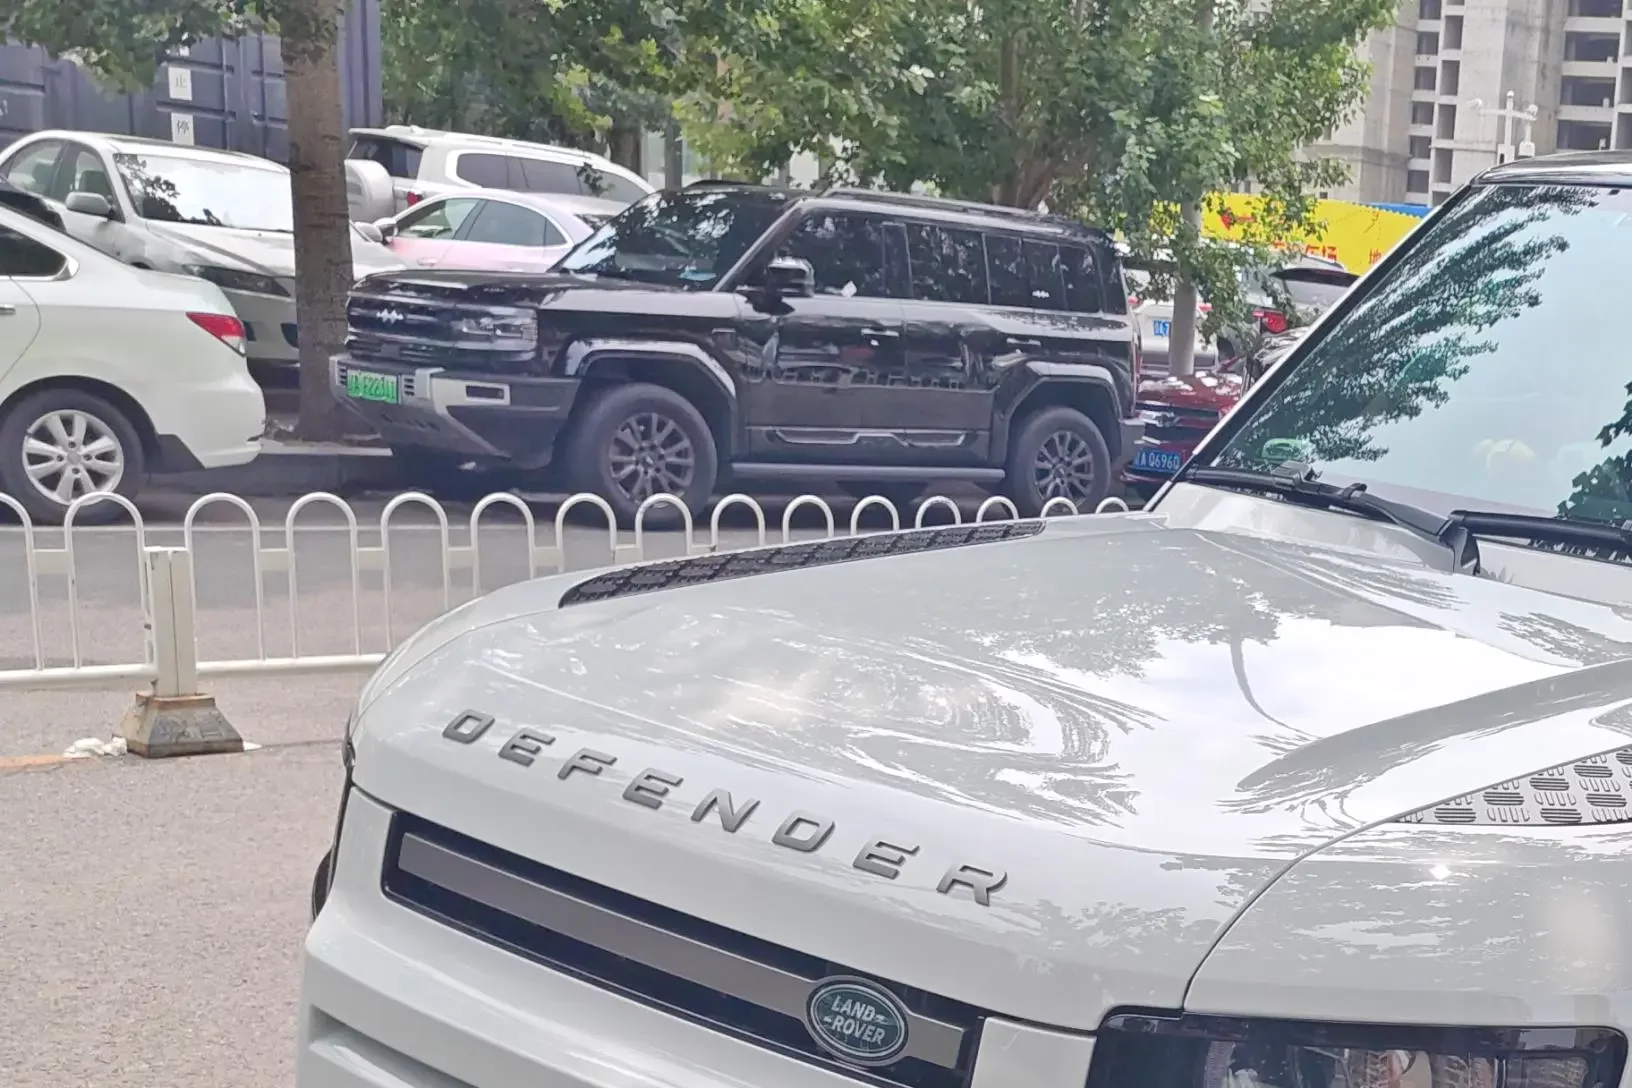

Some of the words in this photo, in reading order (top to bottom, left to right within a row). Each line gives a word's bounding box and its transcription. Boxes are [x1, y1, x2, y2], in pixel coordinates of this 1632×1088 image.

[441, 708, 1008, 907] DEFENDER
[831, 994, 876, 1022] LAND
[831, 1014, 886, 1045] ROVER
